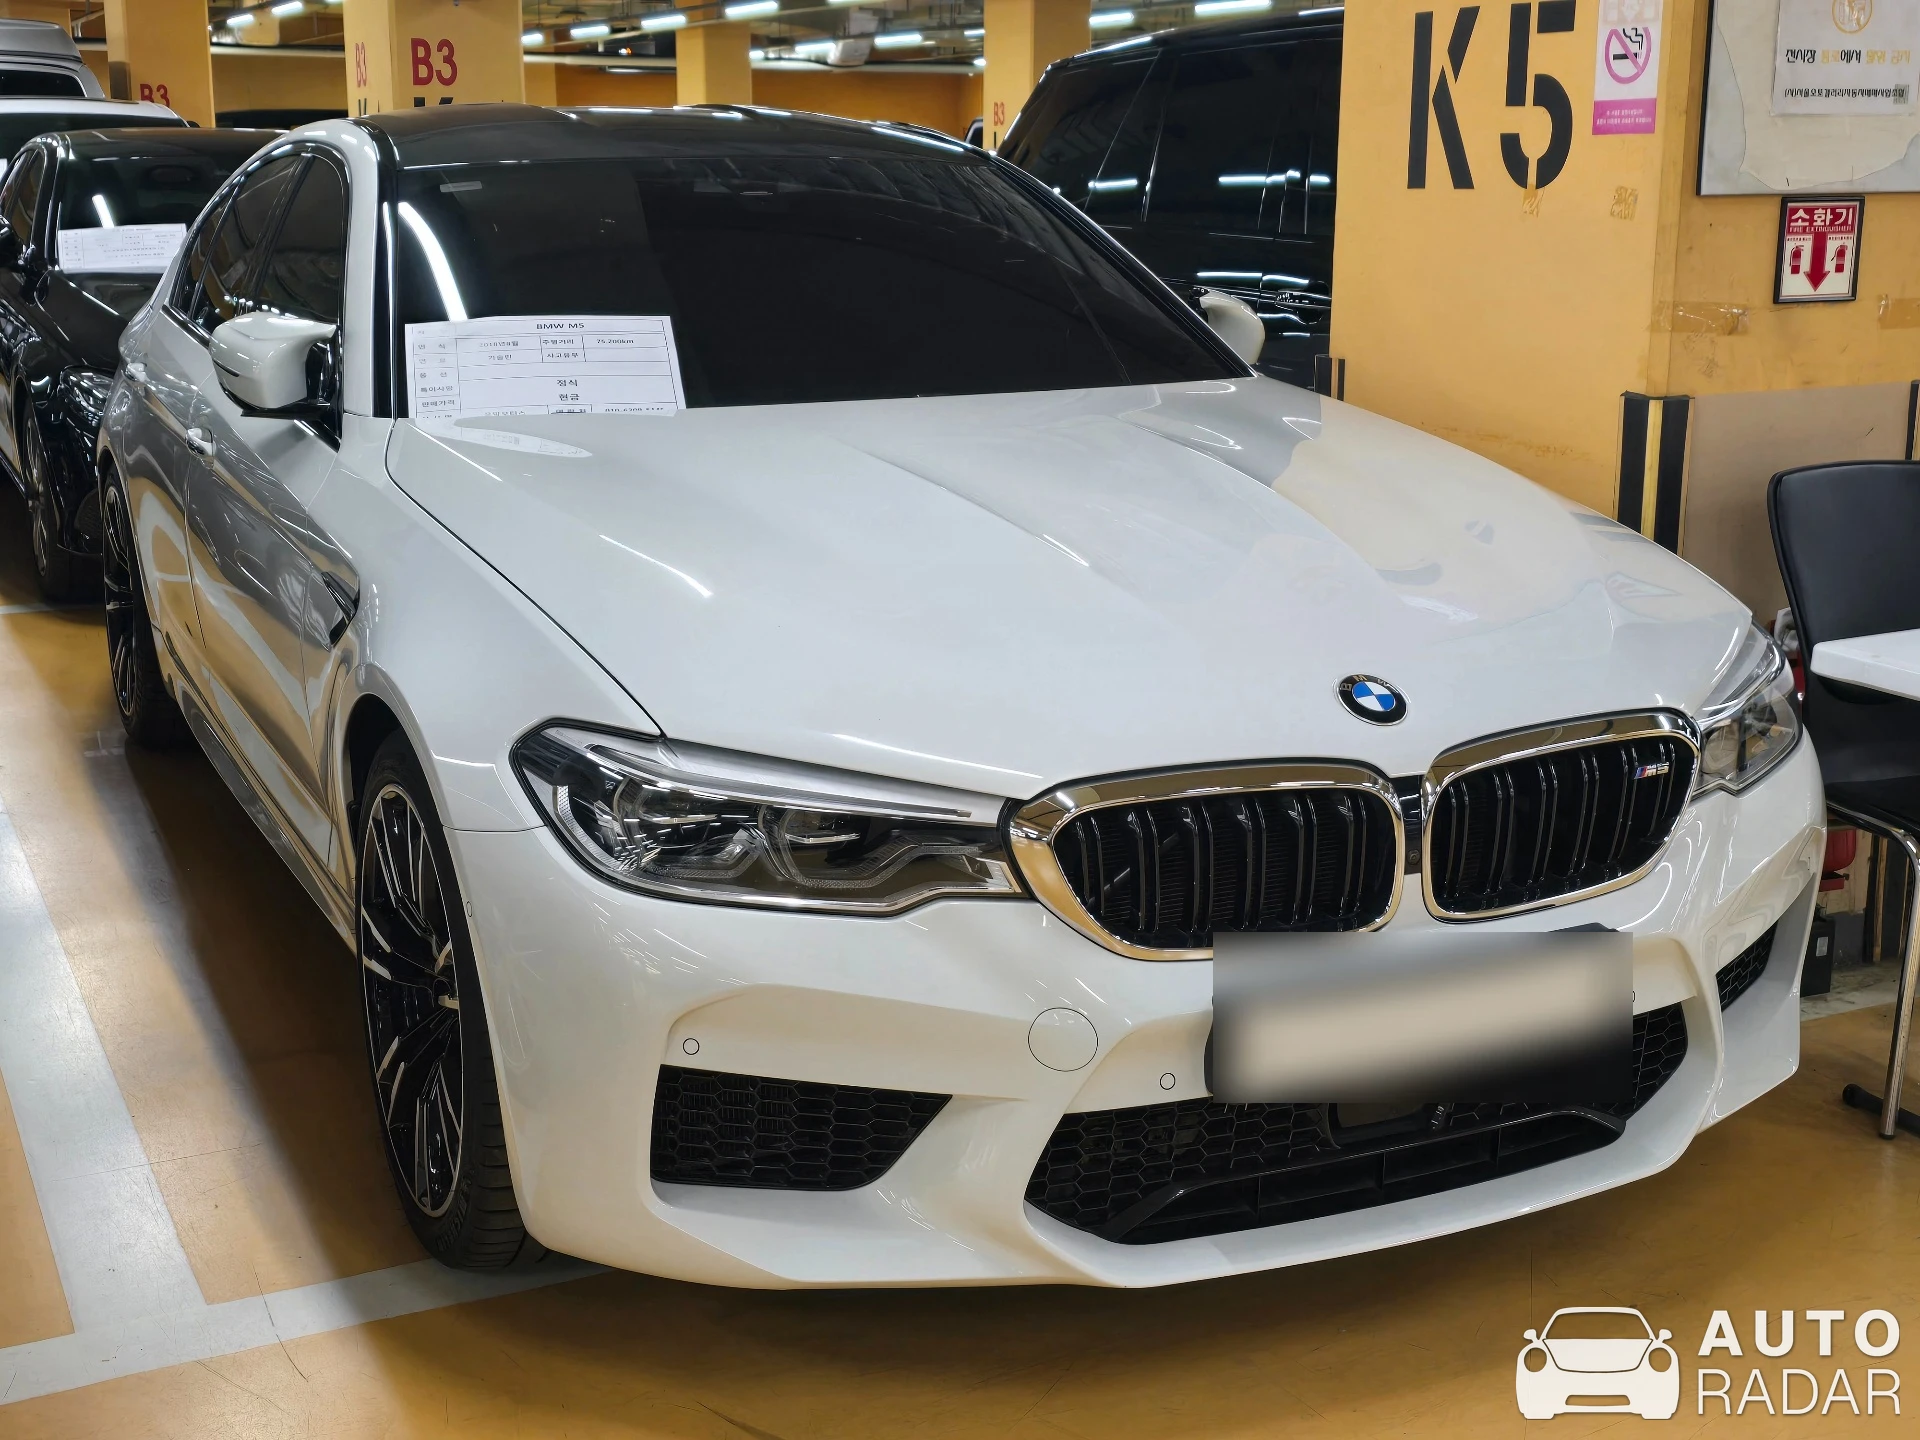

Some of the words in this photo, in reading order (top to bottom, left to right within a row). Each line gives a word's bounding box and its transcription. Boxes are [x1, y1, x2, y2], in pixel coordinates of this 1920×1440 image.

[355, 42, 367, 88] B3
[411, 38, 458, 86] B3
[1785, 49, 1817, 64] 전시장
[1407, 0, 1577, 189] K5
[993, 102, 1005, 126] B3
[1790, 208, 1853, 226] 소화기
[558, 393, 580, 401] 현금
